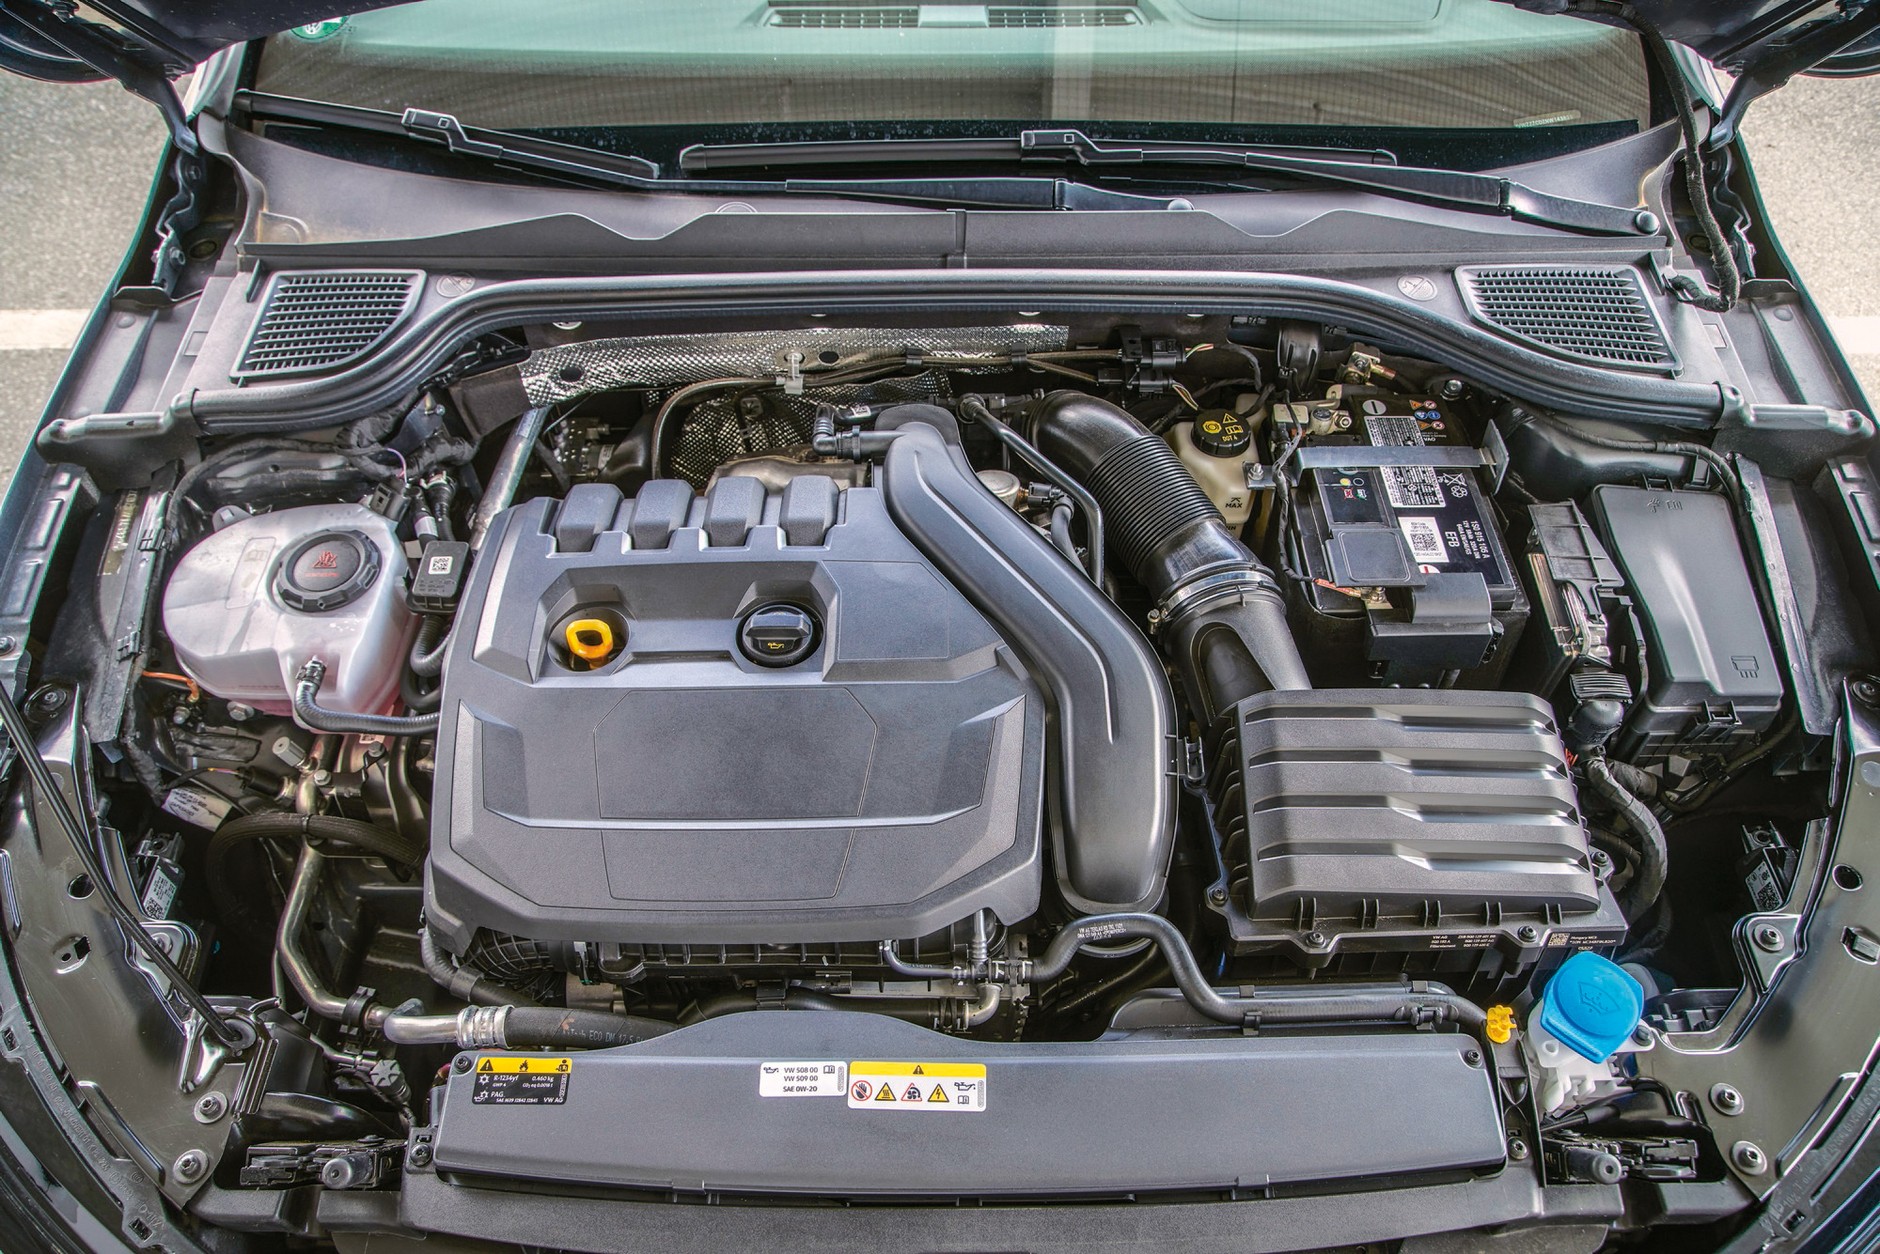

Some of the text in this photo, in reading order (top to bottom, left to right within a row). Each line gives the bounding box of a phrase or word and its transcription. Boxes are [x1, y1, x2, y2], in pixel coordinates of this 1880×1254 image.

[1445, 531, 1460, 548] EFB
[589, 1030, 603, 1042] ECO
[493, 1074, 519, 1082] R-1234yf
